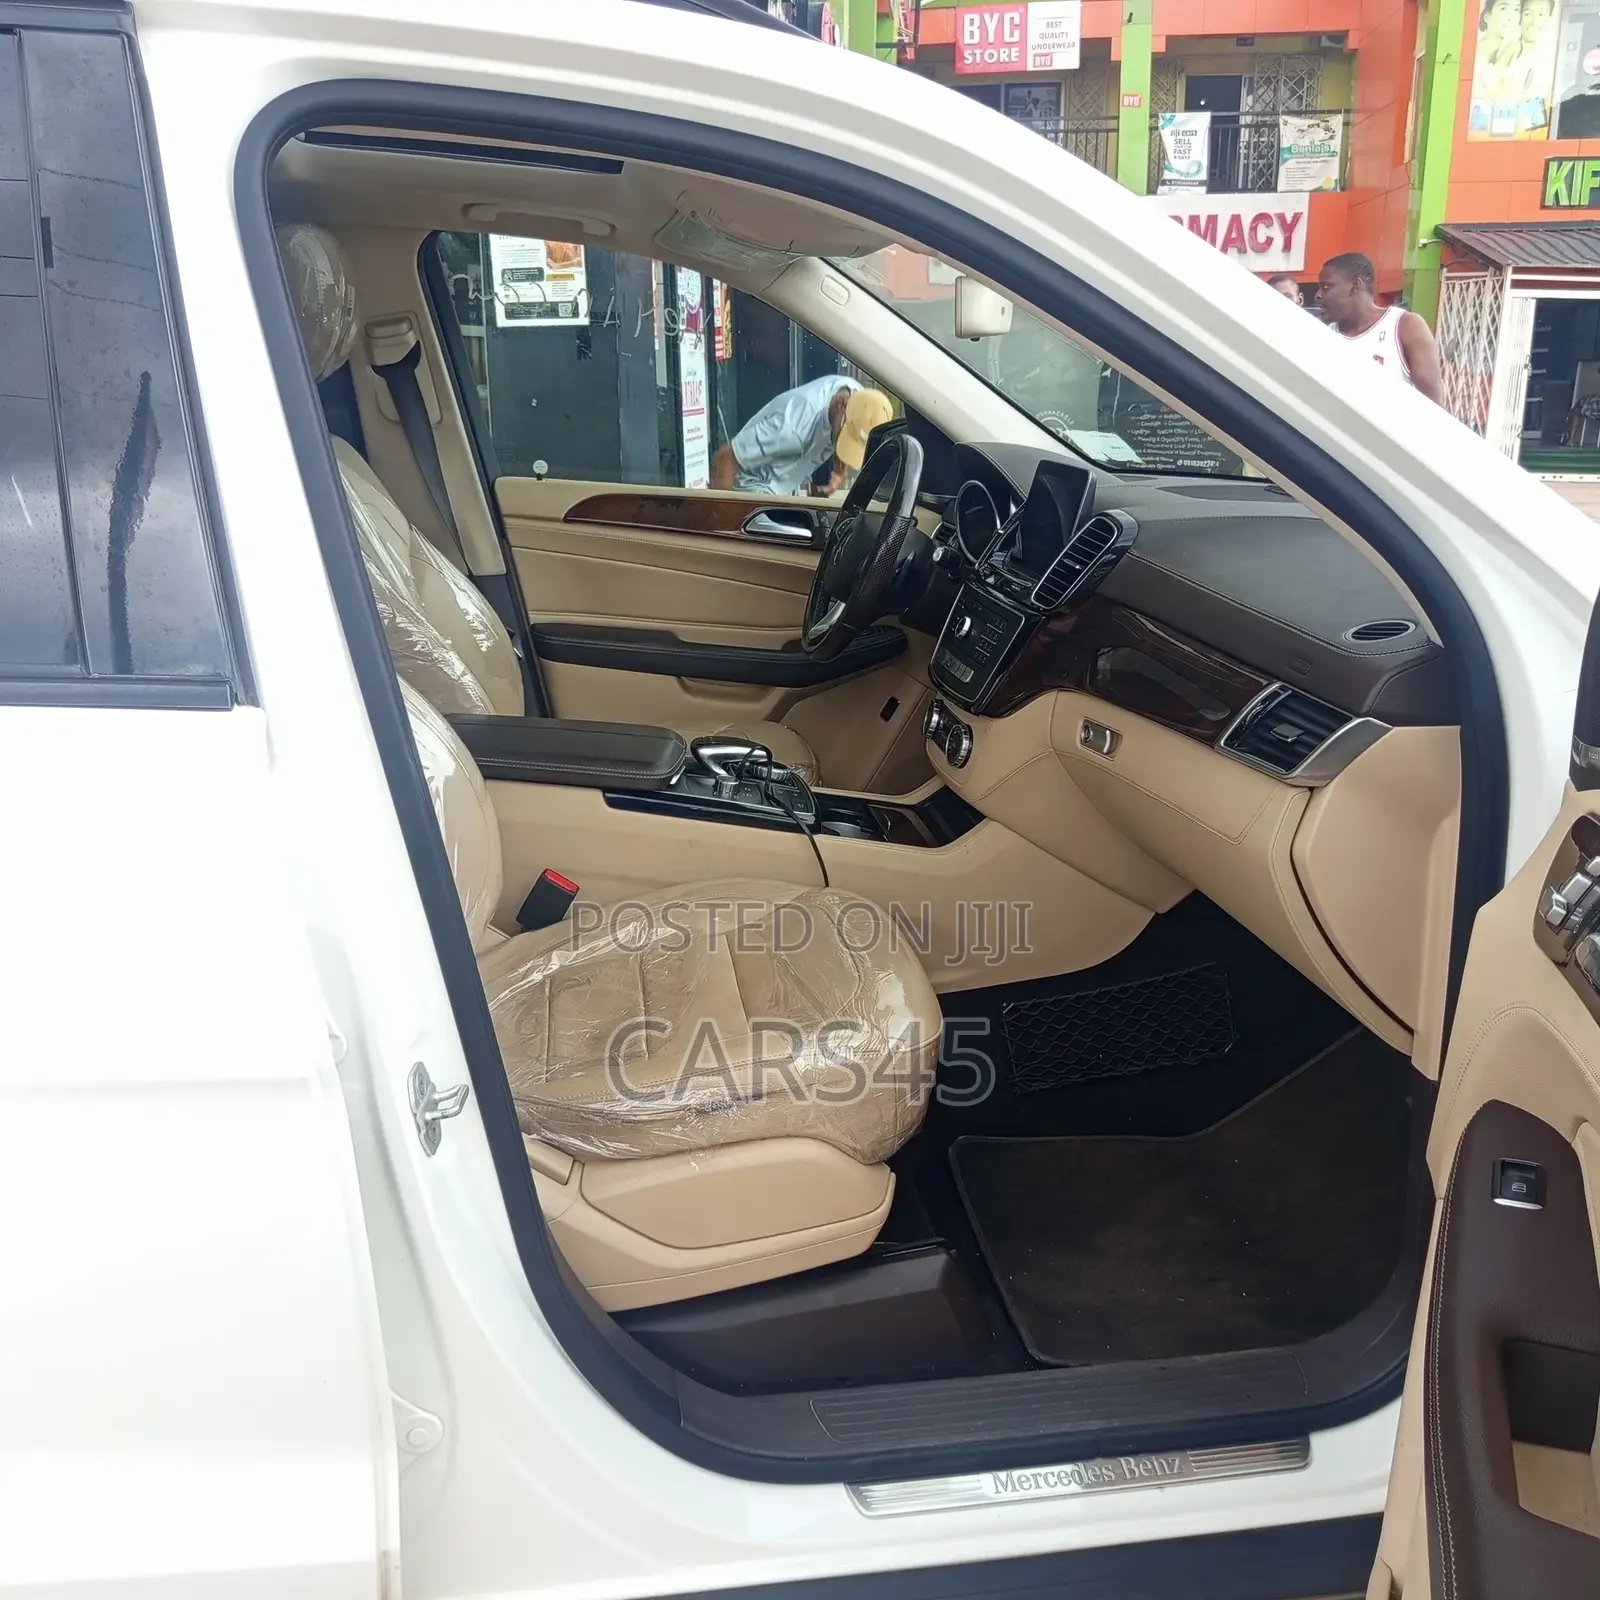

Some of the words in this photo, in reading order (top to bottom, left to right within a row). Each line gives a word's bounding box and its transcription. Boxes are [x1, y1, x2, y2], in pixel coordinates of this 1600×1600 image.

[963, 12, 1020, 45] BYC
[1045, 21, 1062, 29] BEST
[1038, 32, 1069, 40] QUALITY
[1031, 42, 1076, 51] UNDERWEAR
[963, 47, 1020, 65] STORE
[1174, 138, 1192, 146] SELL
[988, 1460, 1116, 1495] Mercedes
[1118, 1454, 1186, 1480] Benz
